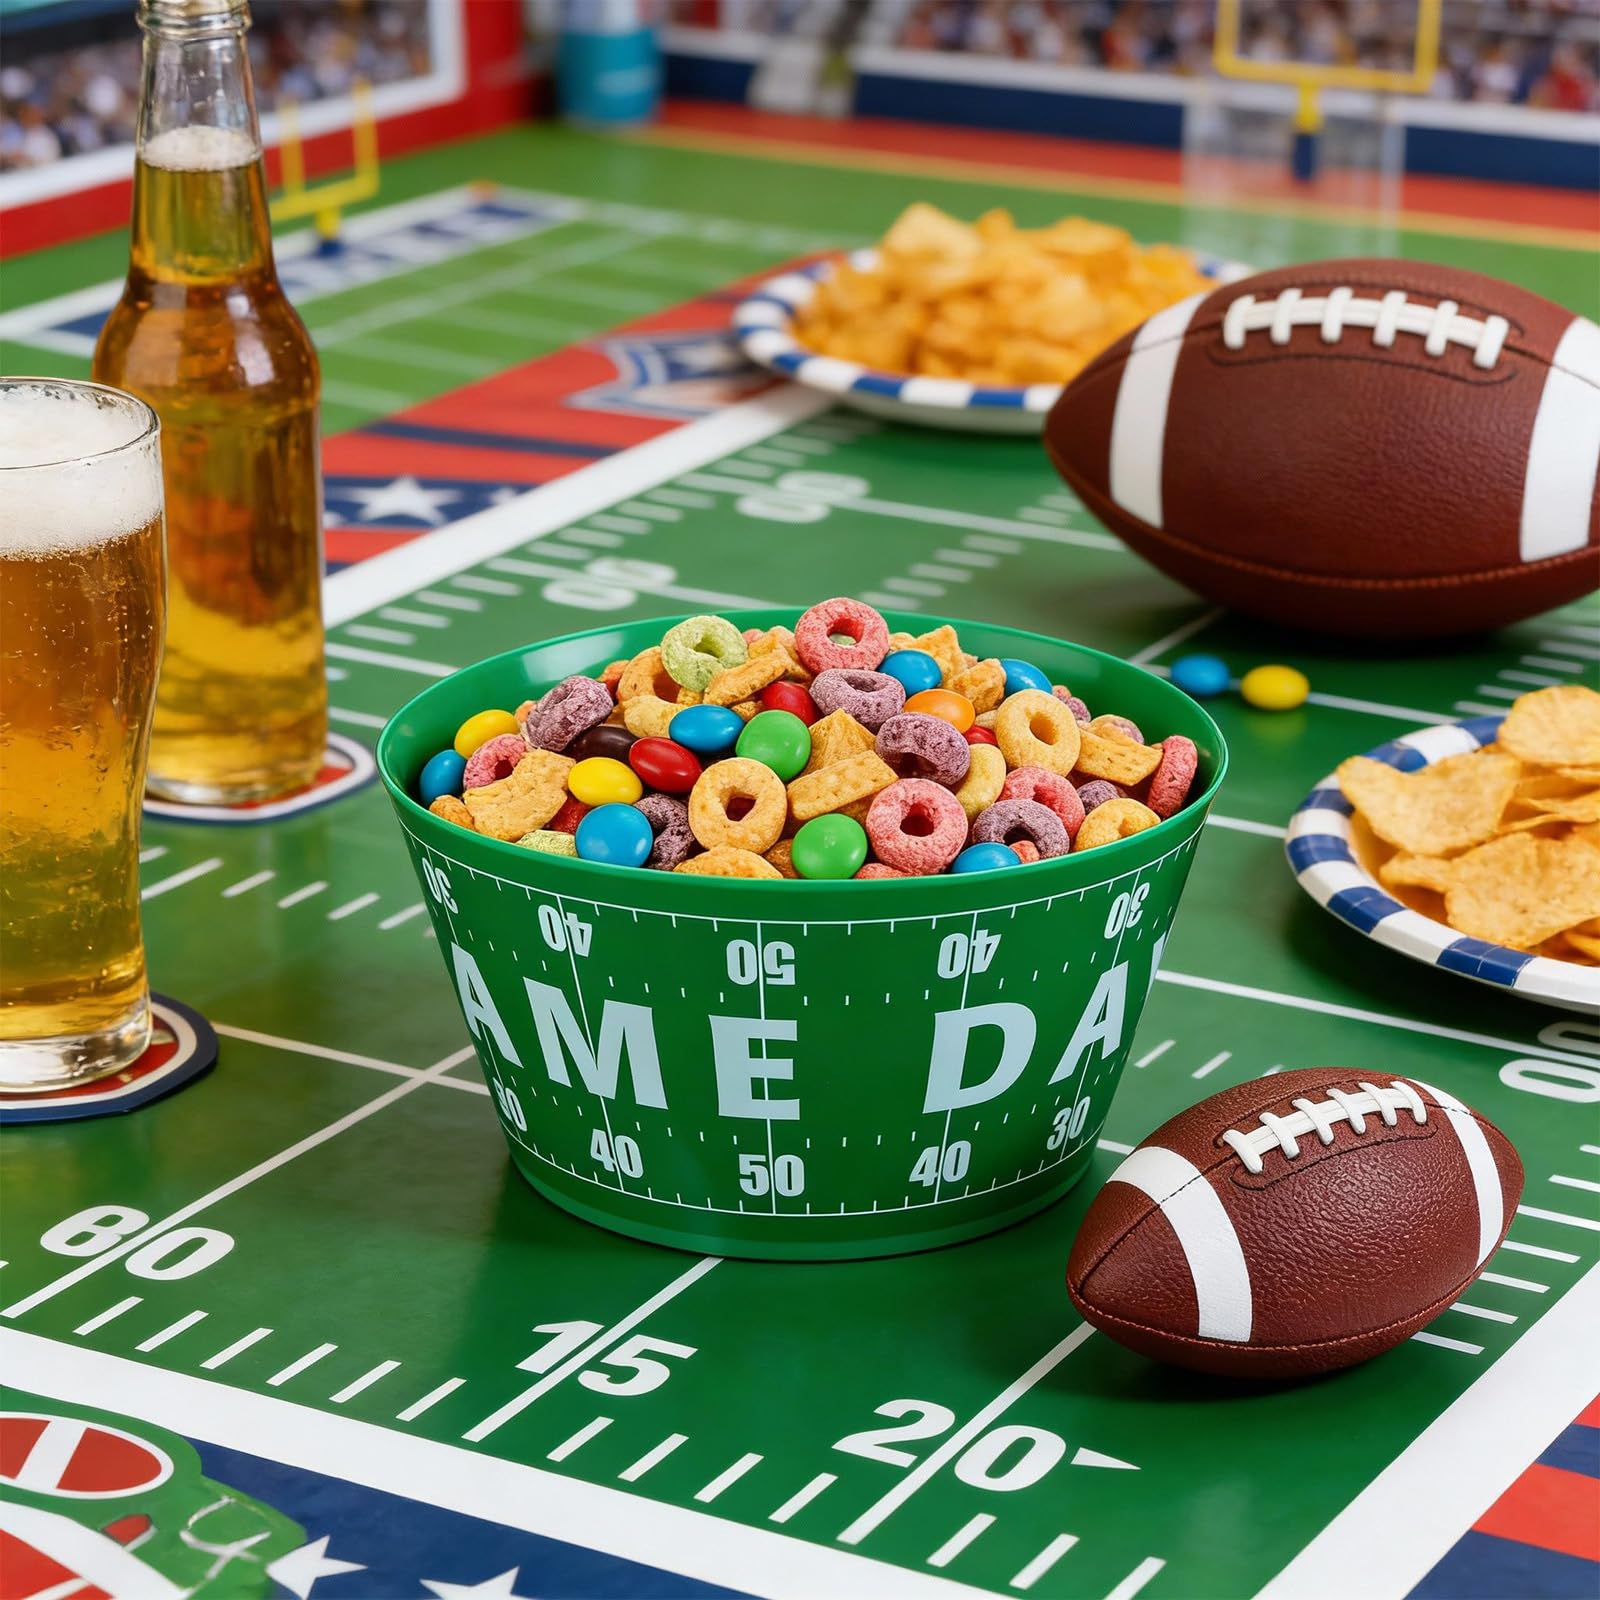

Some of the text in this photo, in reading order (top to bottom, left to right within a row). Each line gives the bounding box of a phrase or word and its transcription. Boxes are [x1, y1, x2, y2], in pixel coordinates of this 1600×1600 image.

[537, 904, 593, 958] 40
[726, 939, 796, 986] 50
[937, 929, 1002, 980] 40
[1104, 882, 1151, 940] 30
[590, 1128, 644, 1179] 40
[738, 1153, 805, 1197] 50
[908, 1140, 972, 1187] 40
[1046, 1095, 1091, 1150] 30
[514, 1319, 699, 1396] 15
[831, 1398, 1068, 1492] 20
